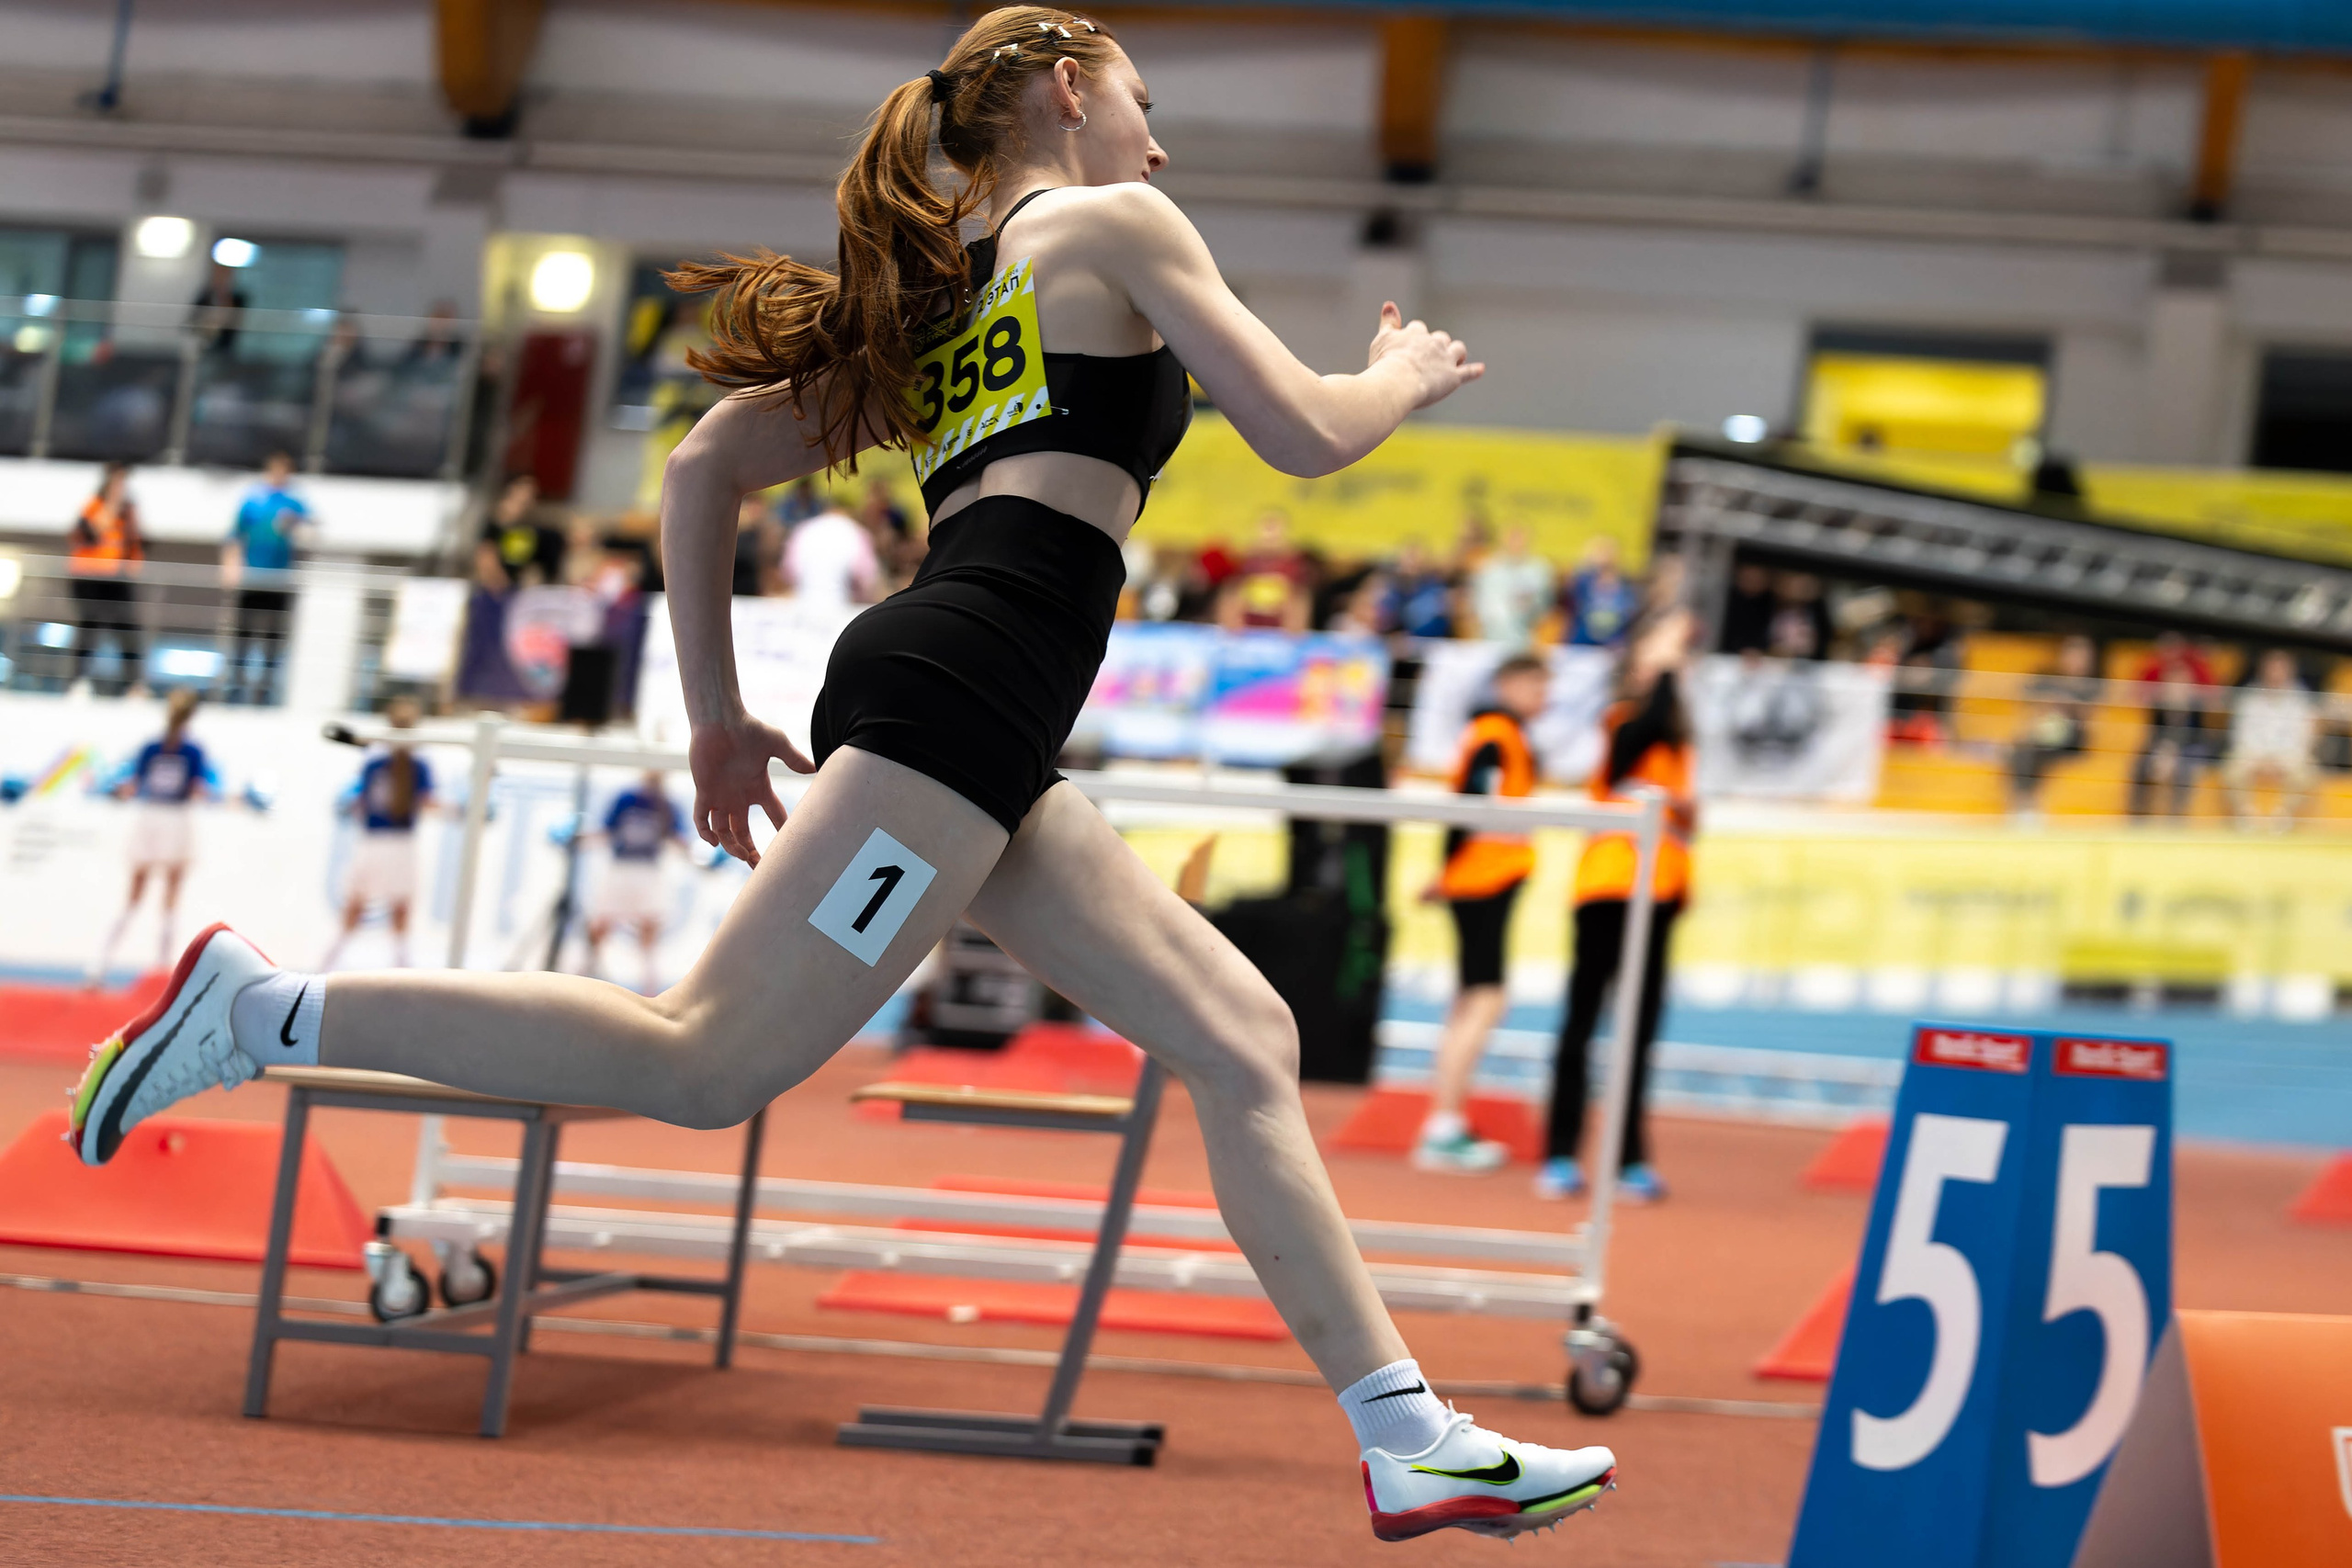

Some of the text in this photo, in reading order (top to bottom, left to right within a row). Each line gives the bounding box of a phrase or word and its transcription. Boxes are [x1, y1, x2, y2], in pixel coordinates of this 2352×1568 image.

[987, 276, 1020, 305] ЭТАП
[916, 316, 1025, 434] 358
[851, 864, 905, 933] 1
